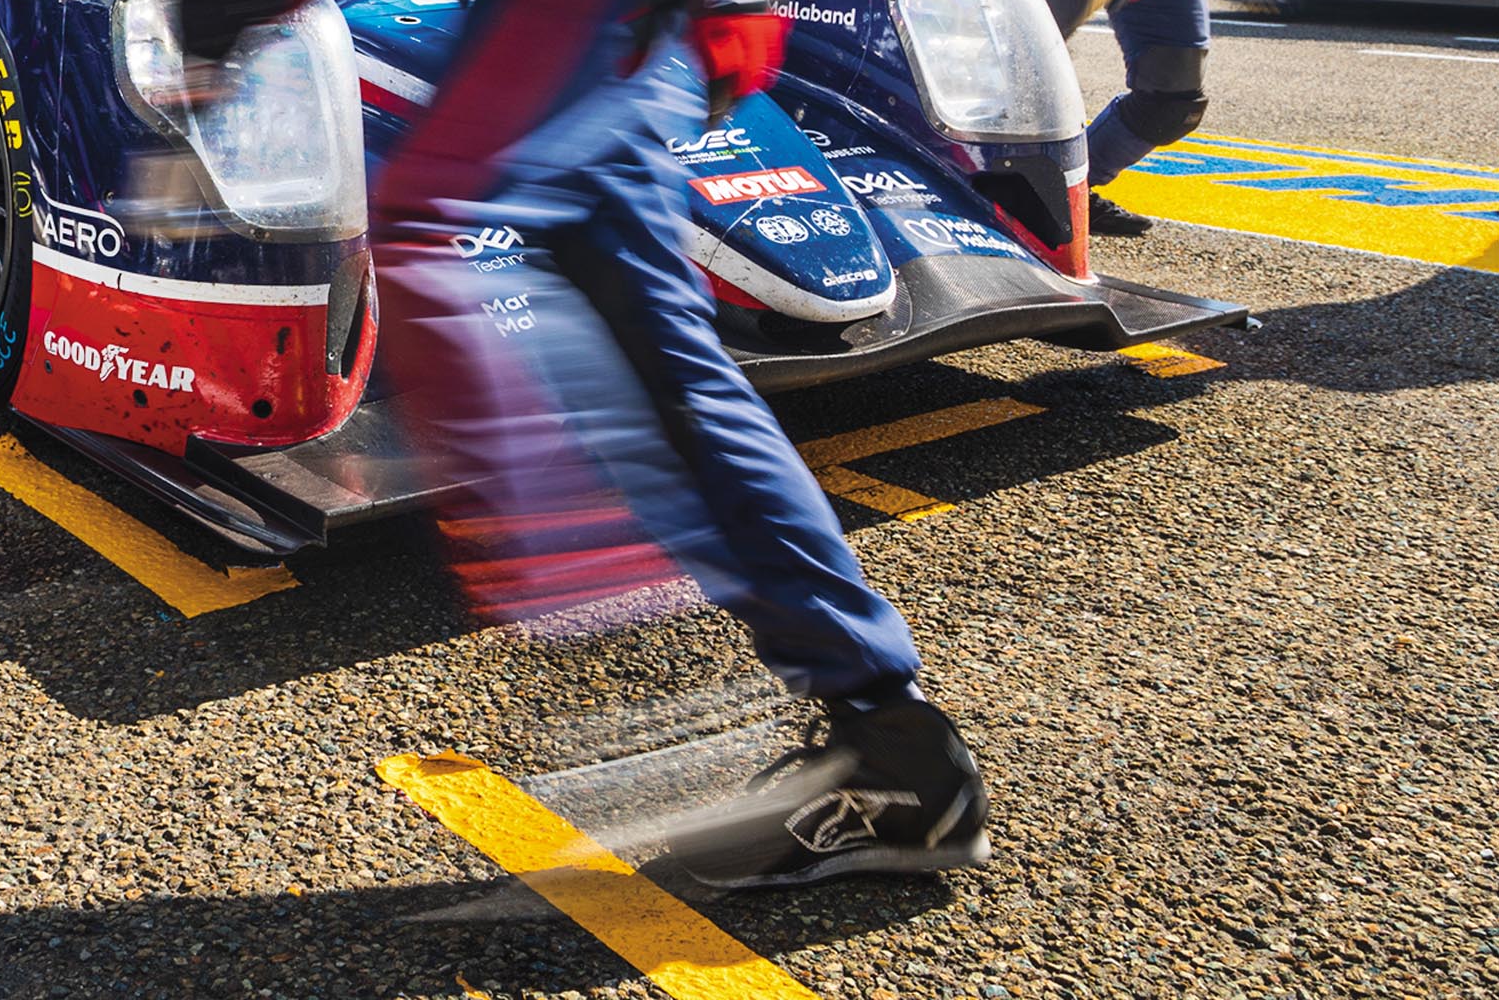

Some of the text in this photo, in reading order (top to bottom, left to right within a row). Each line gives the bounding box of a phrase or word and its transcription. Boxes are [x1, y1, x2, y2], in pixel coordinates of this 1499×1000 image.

[703, 171, 818, 201] MOTUL
[841, 170, 928, 195] DELL
[41, 212, 121, 258] AERO
[940, 218, 988, 235] Maria
[43, 330, 196, 393] GOODYEAR
